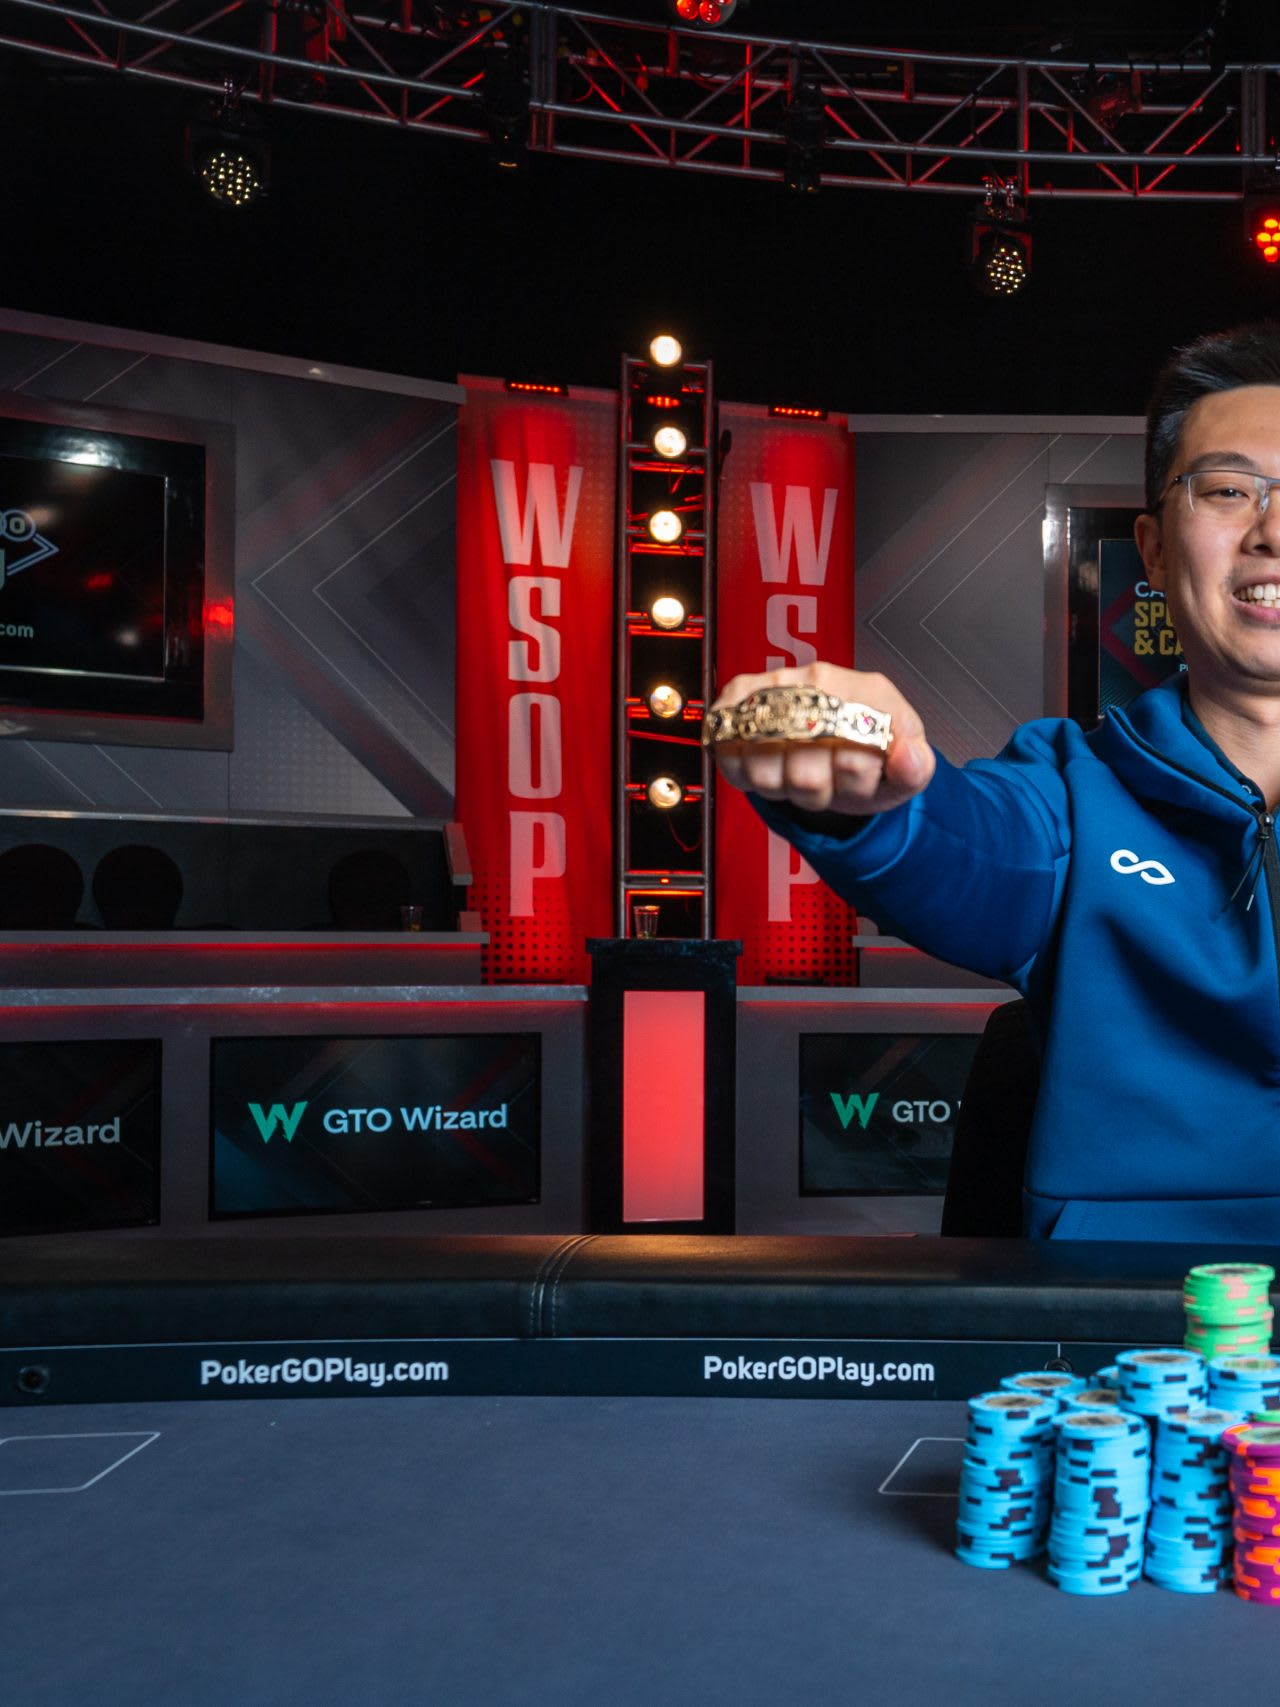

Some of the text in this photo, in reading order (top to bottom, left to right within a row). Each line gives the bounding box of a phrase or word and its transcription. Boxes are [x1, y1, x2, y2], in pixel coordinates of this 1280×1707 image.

[491, 459, 583, 917] WSOP
[750, 482, 838, 923] WSP
[322, 1107, 393, 1134] GTO
[399, 1103, 508, 1131] Wizard
[891, 1100, 951, 1123] GTO
[0, 1116, 121, 1149] Wizard
[200, 1357, 449, 1388] PokerGOPlay.com
[702, 1355, 936, 1387] PokerGOPlay.com
